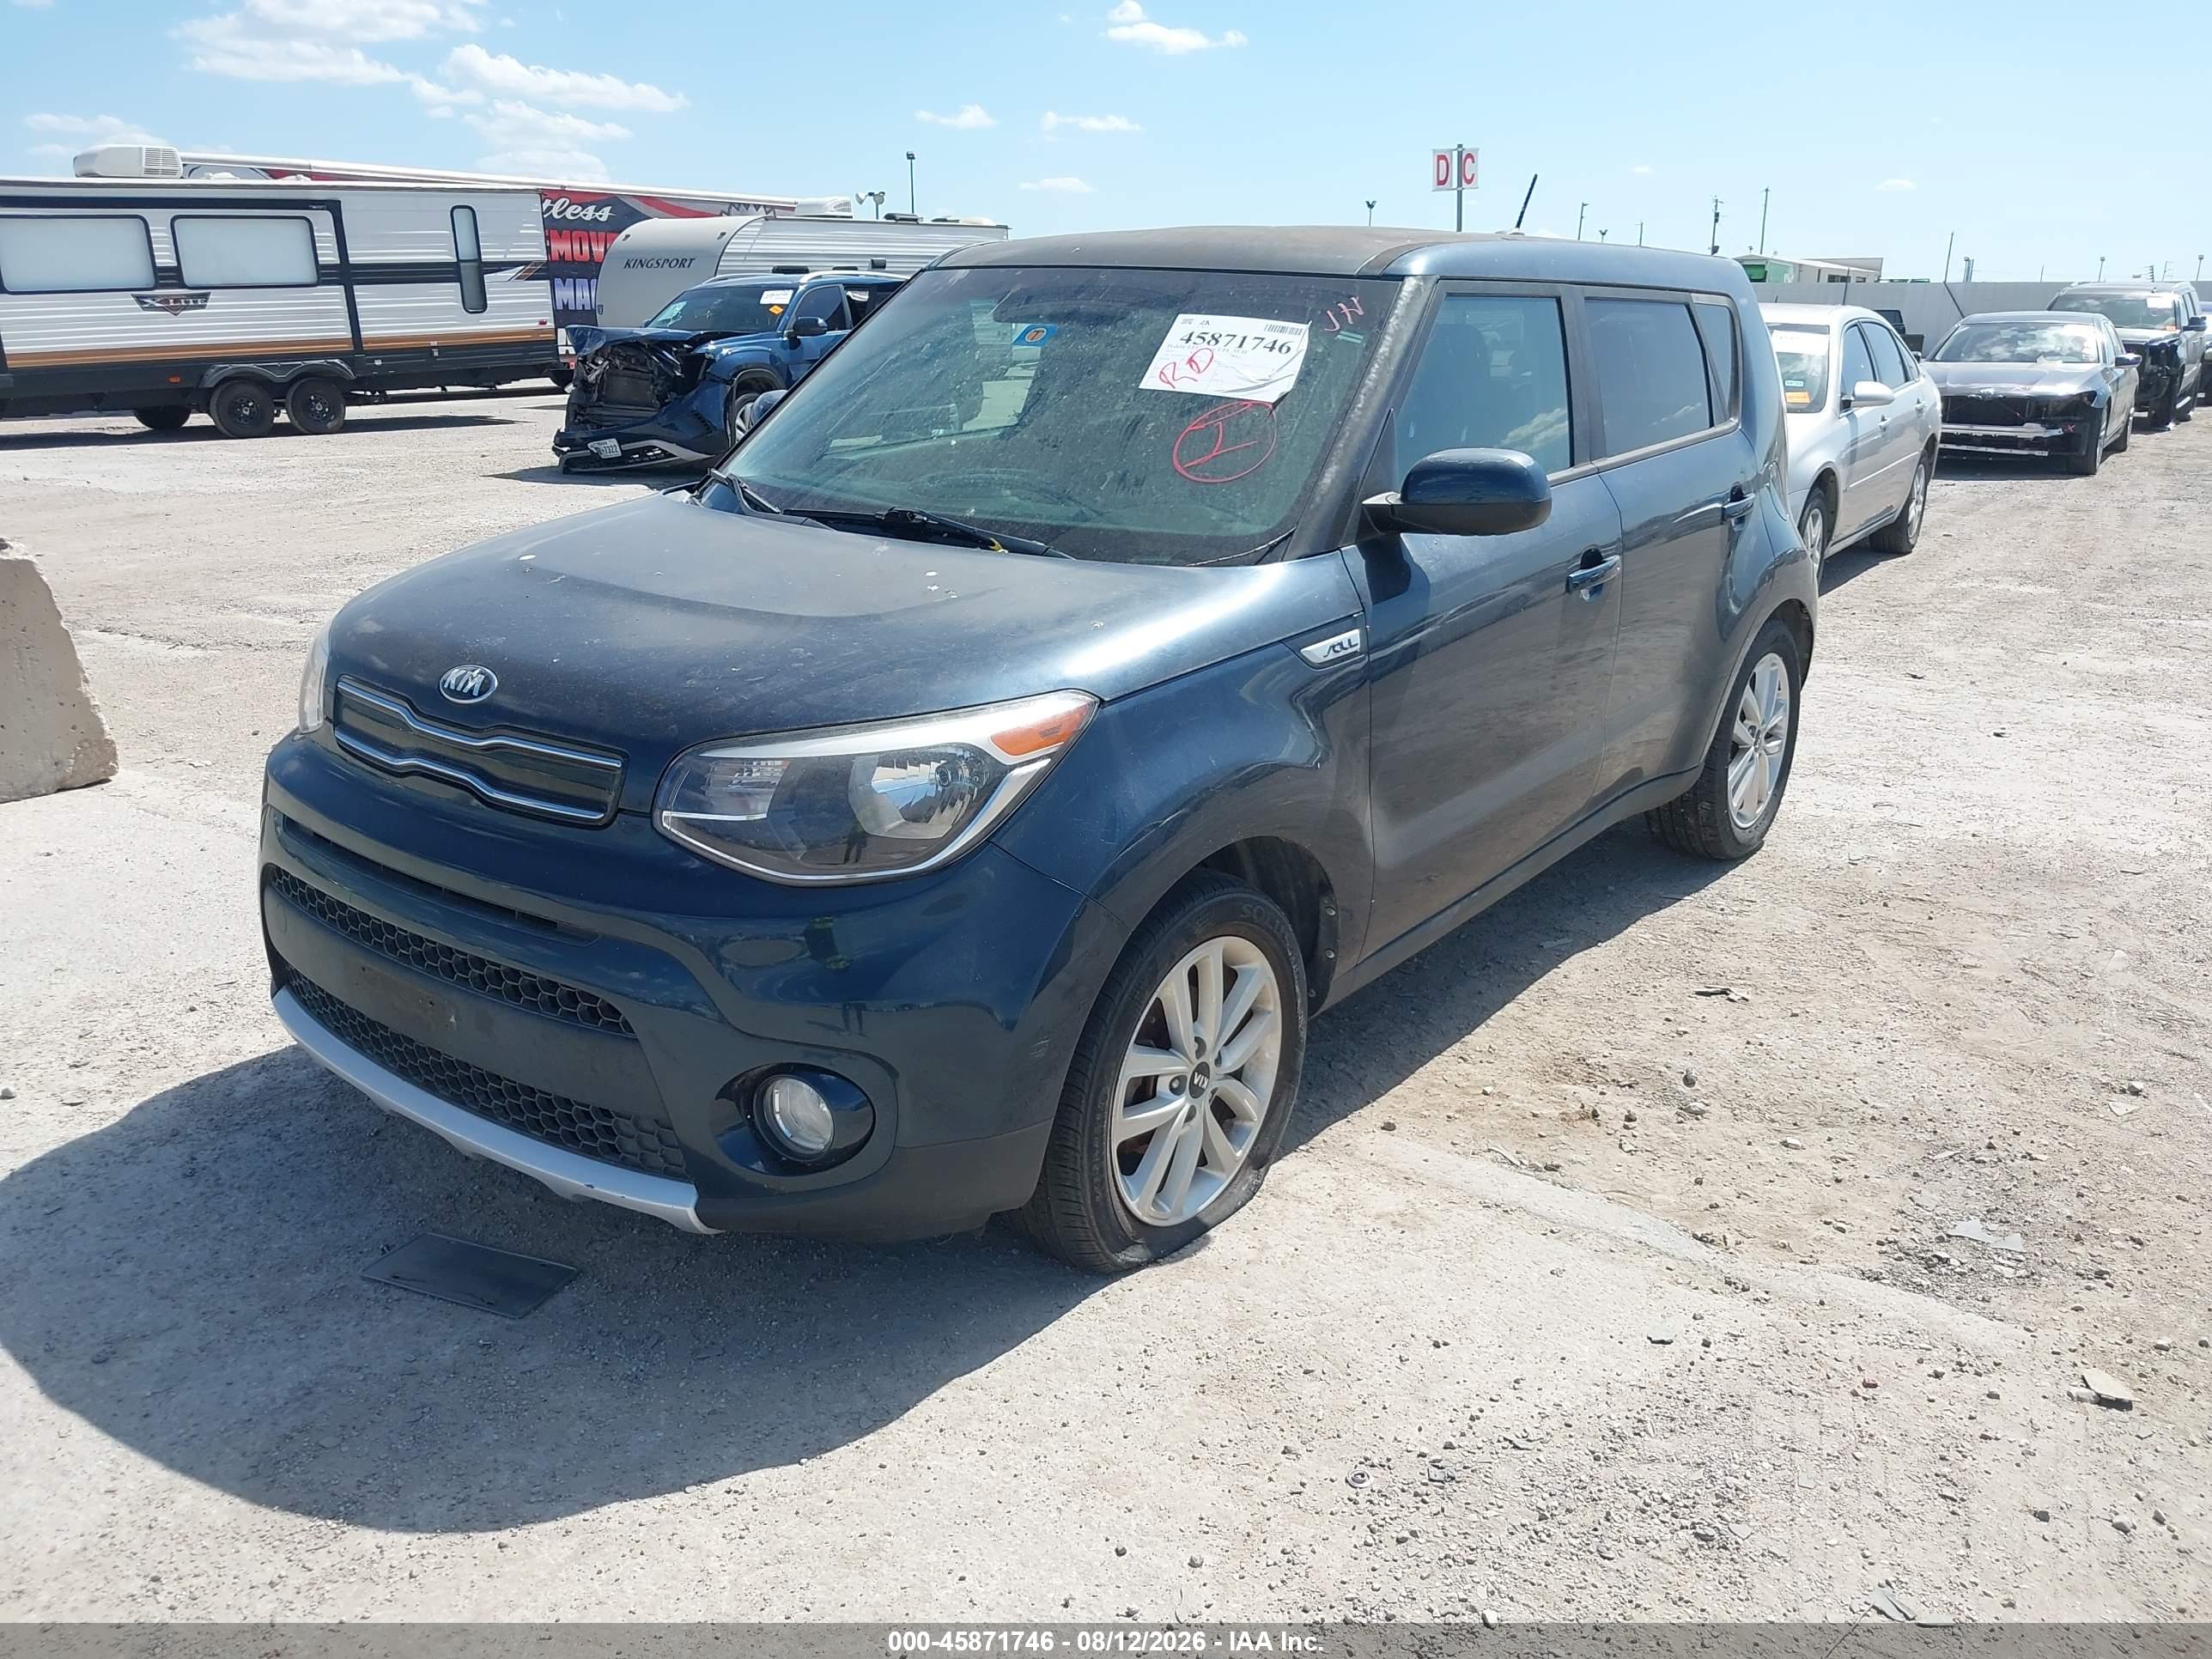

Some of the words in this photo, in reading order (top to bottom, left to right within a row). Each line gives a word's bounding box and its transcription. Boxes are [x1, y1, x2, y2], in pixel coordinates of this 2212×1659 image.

[1436, 154, 1449, 186] D
[1462, 152, 1475, 185] C
[545, 229, 619, 262] MOV
[623, 258, 696, 269] KINGSPORT
[1180, 331, 1295, 355] 45871746
[443, 668, 486, 696] KIA
[1194, 1072, 1209, 1090] KIA
